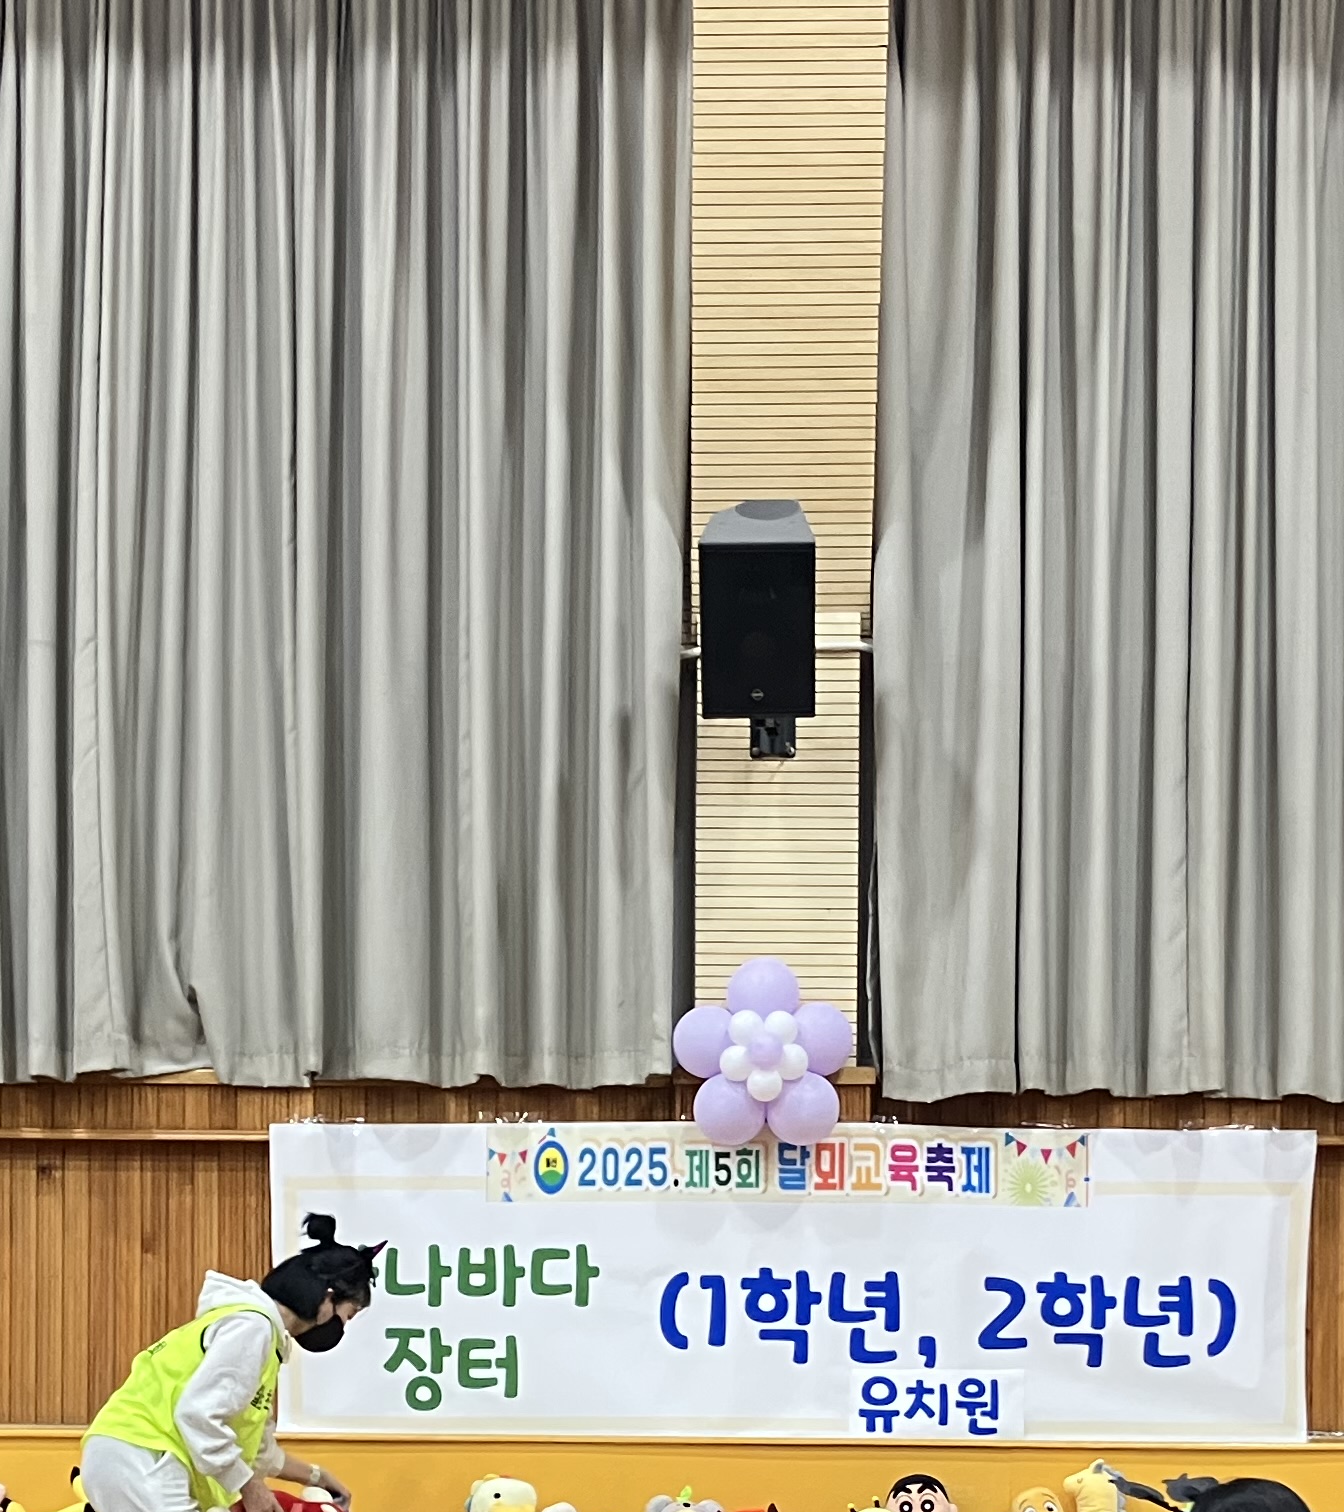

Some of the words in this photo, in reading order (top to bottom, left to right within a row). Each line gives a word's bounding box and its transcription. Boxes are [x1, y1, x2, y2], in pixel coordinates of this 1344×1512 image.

[358, 1243, 600, 1307] 나바다
[660, 1267, 936, 1368] (1학년,
[978, 1271, 1236, 1368] 2학년)
[383, 1327, 518, 1411] 장터
[859, 1375, 999, 1436] 유치원
